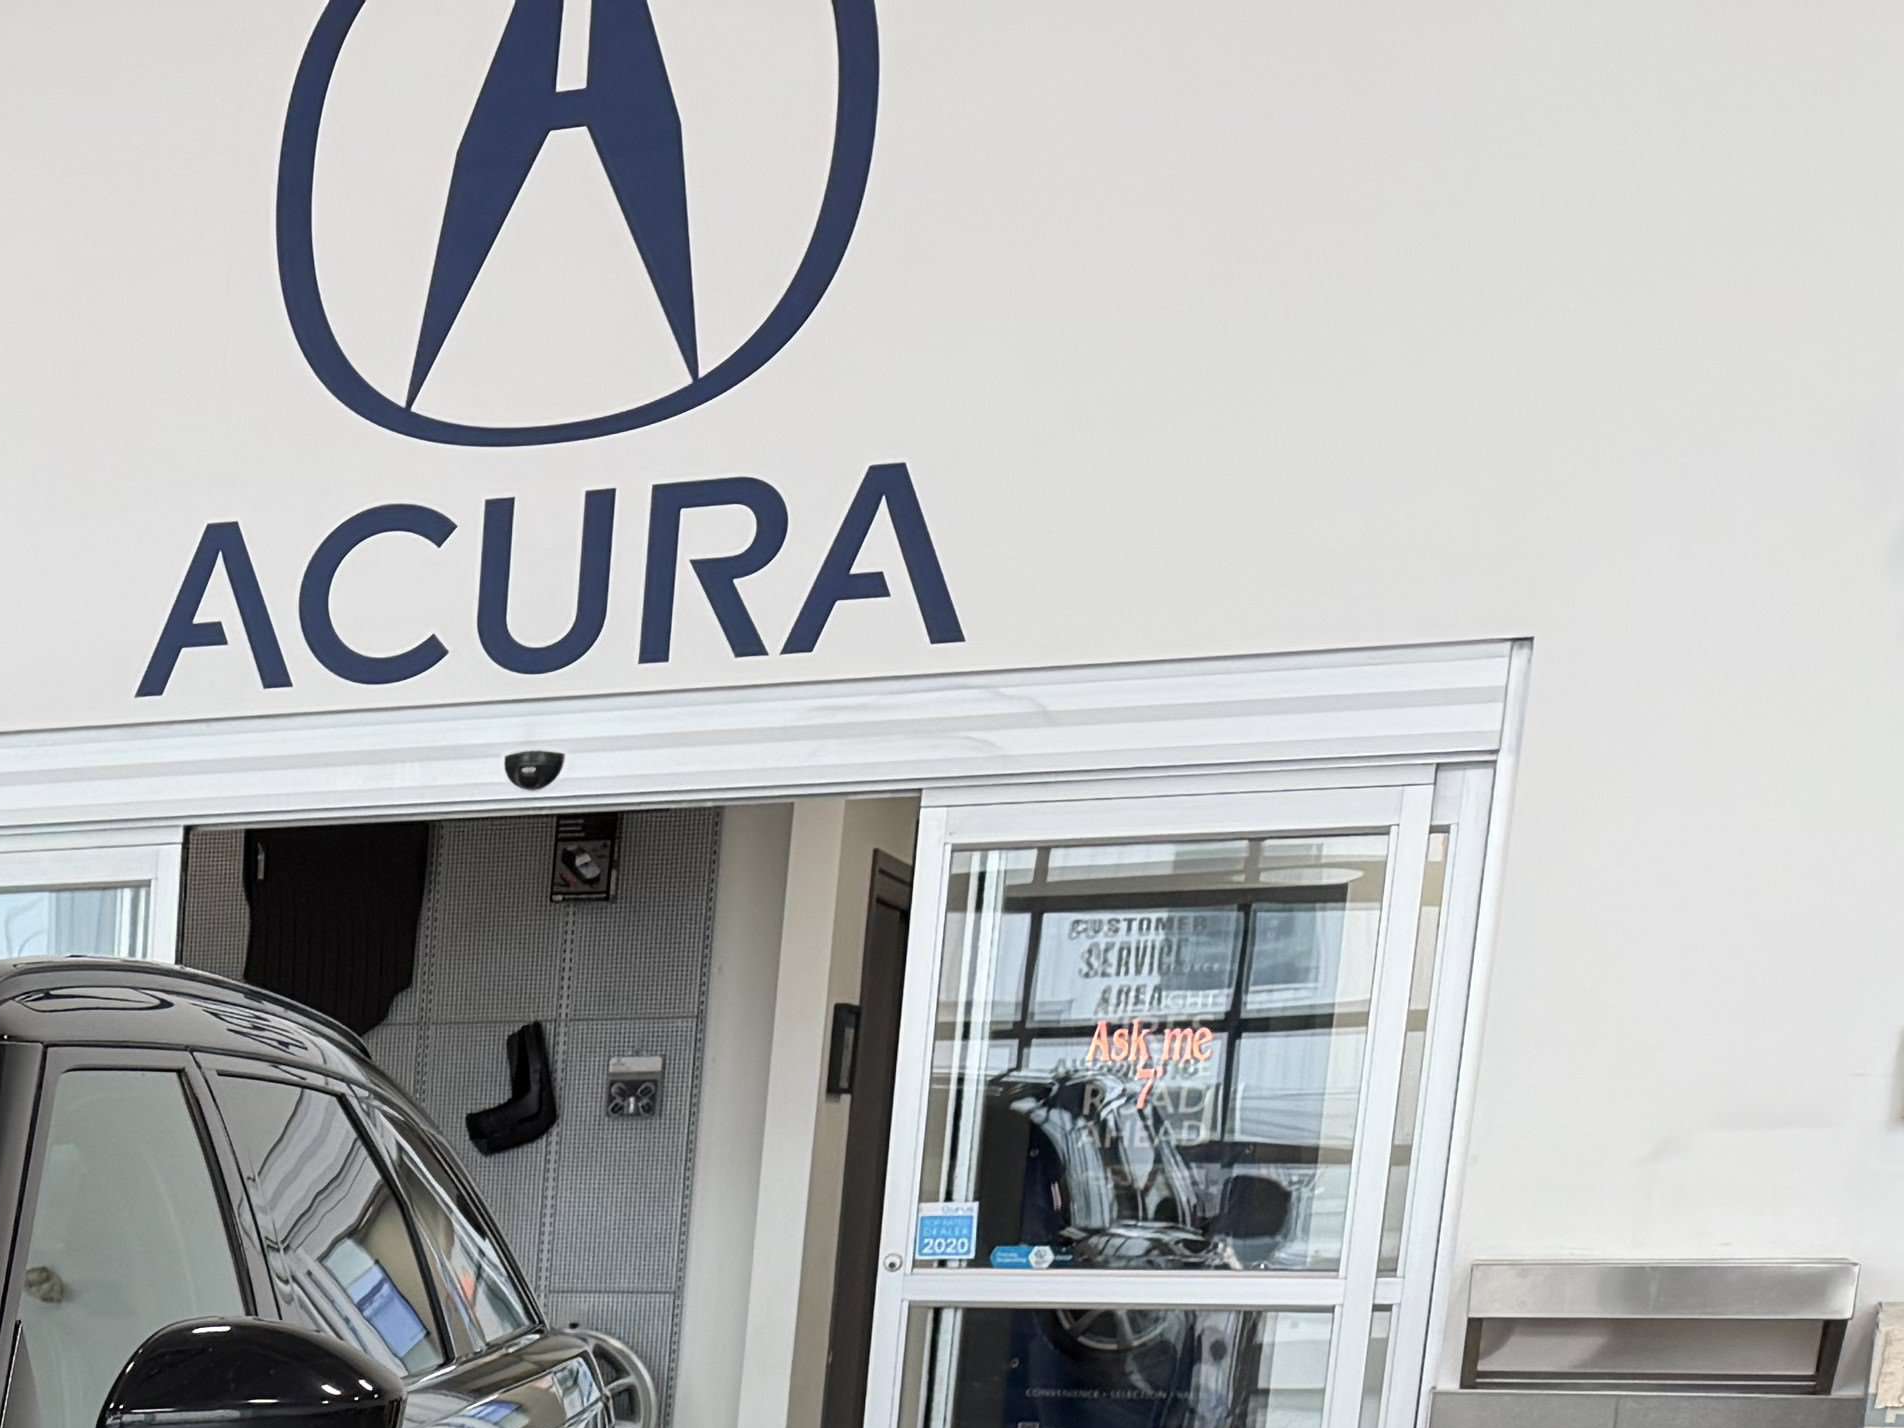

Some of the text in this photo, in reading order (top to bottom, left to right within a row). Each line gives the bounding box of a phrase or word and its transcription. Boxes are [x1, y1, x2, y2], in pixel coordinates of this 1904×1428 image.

[135, 462, 966, 698] ACURA
[1069, 915, 1209, 940] CUSTOMER
[1078, 936, 1191, 978] SERVICE
[1093, 983, 1163, 1015] AREA
[1087, 1018, 1152, 1062] Ask
[1161, 1026, 1214, 1064] me
[921, 1237, 970, 1254] 2020
